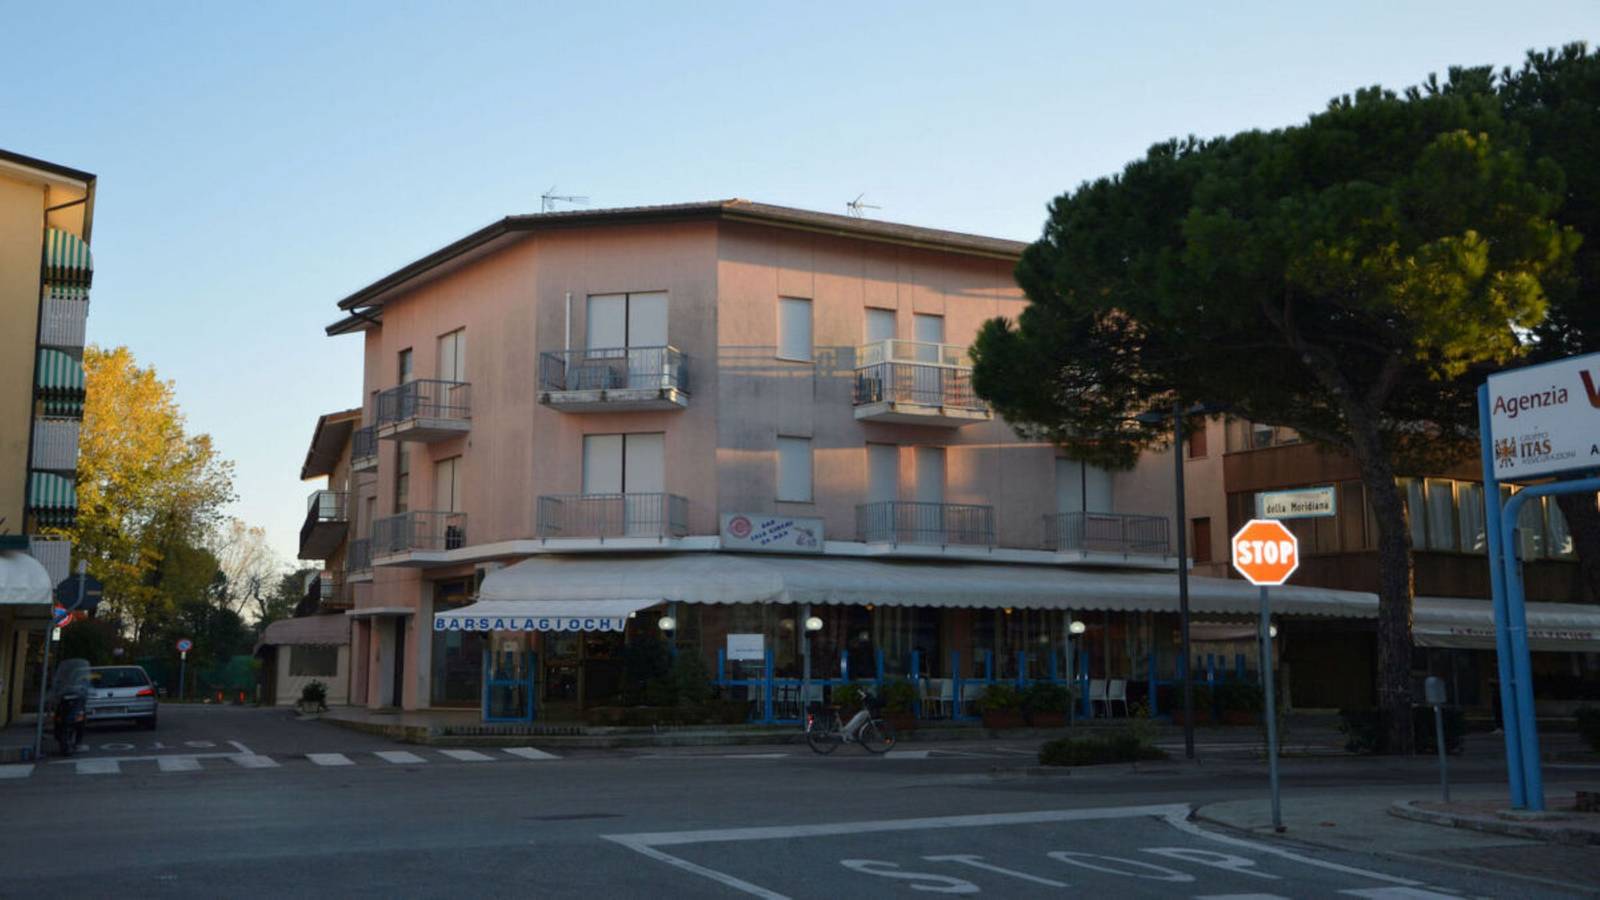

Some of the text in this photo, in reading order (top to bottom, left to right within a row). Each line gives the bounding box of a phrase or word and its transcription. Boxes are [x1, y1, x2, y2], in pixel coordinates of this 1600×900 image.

[1493, 385, 1568, 418] Agenzia
[1520, 440, 1552, 458] ITAS
[1237, 540, 1293, 565] STOP
[840, 848, 1283, 893] STOP
